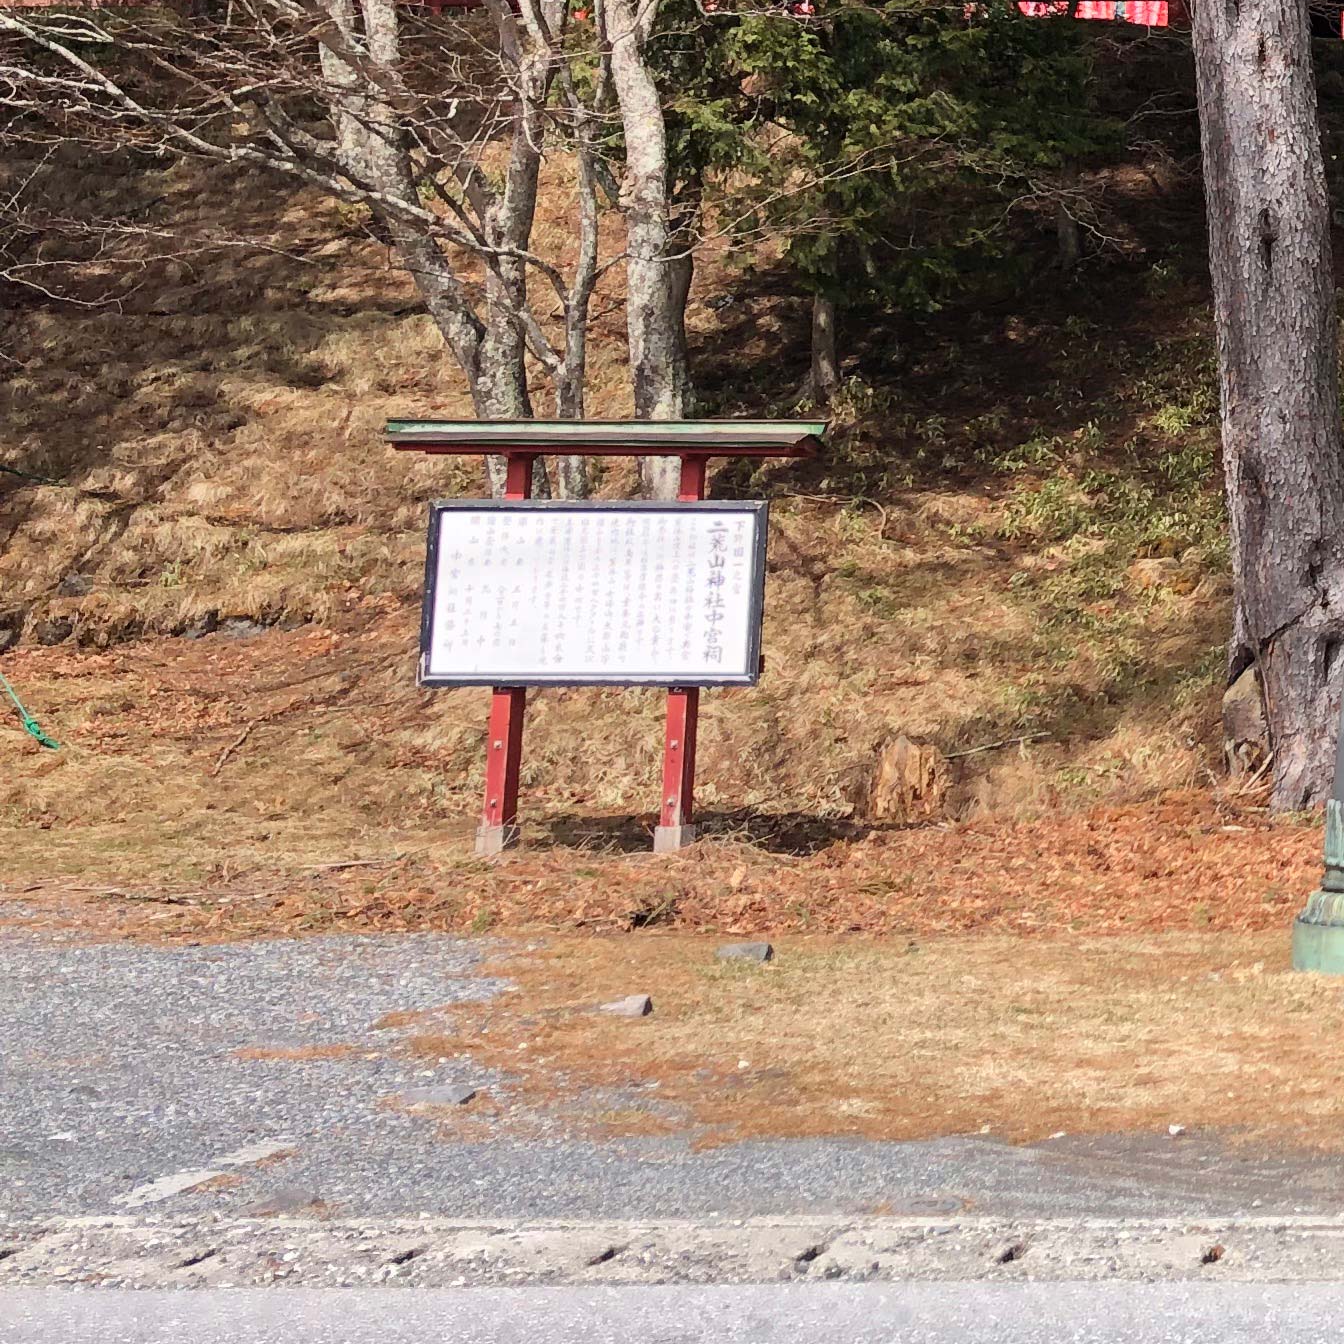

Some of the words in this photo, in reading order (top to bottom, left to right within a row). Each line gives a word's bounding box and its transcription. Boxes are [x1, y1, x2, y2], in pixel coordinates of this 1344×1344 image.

[702, 520, 729, 664] 二荒山神社中宮祠
